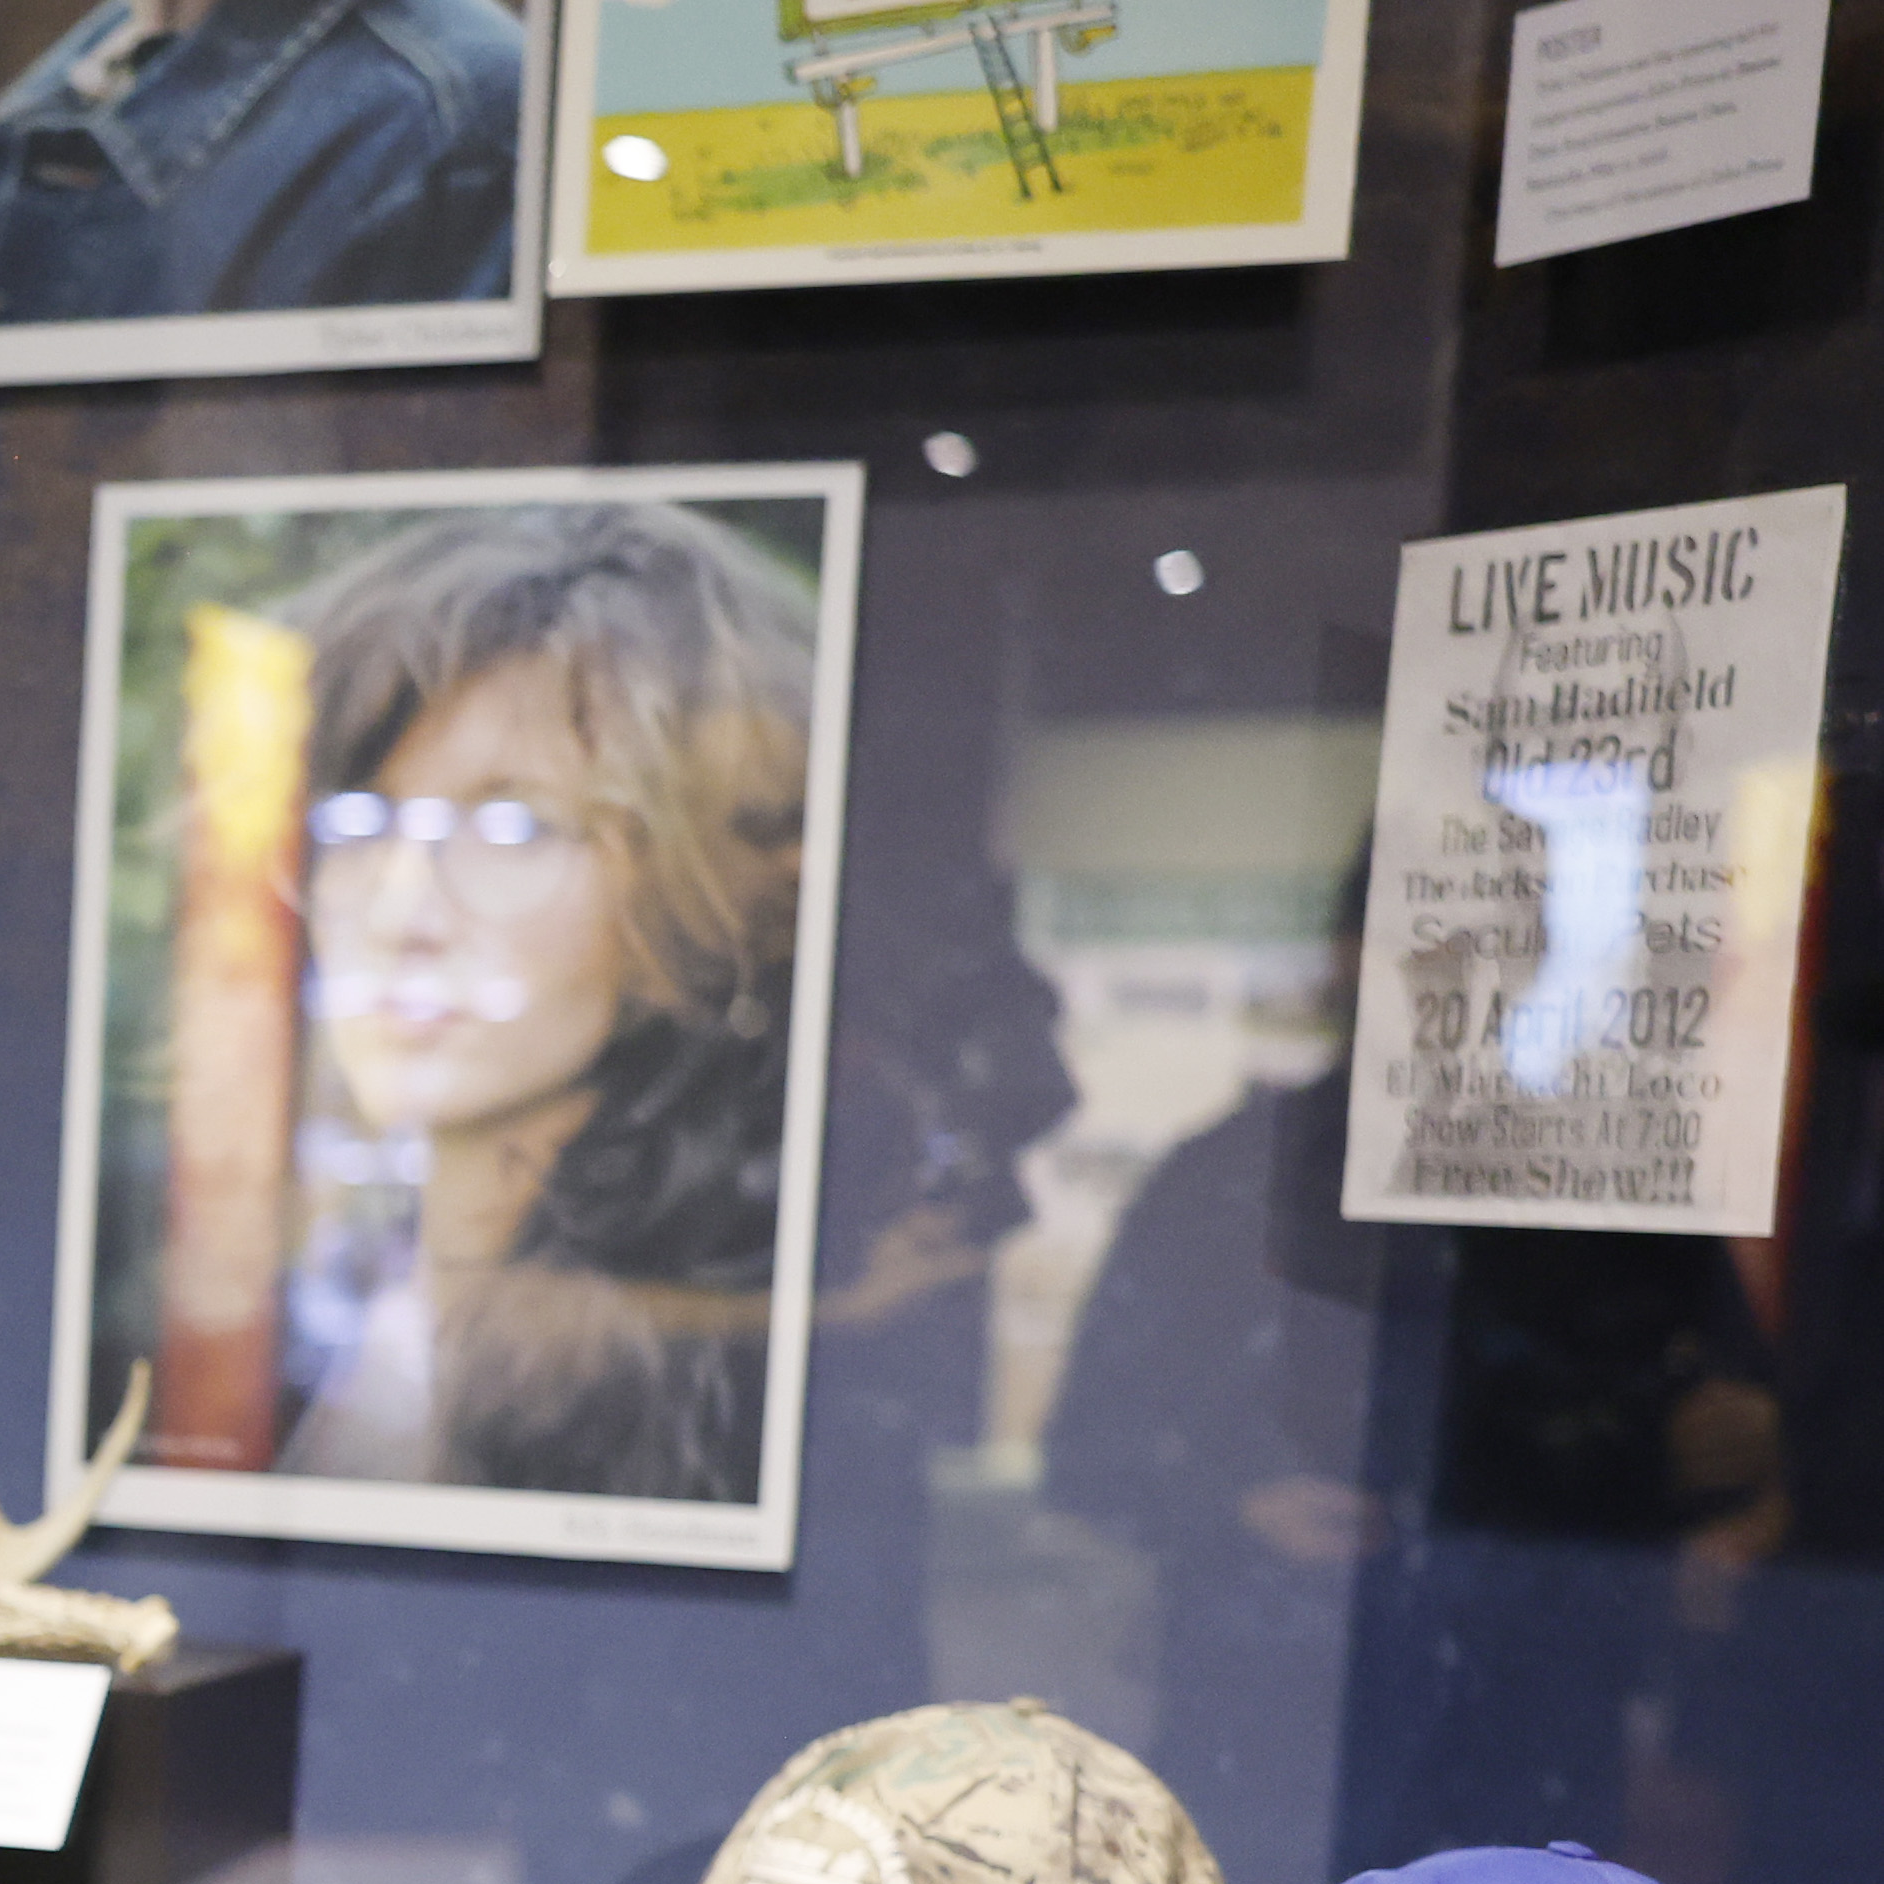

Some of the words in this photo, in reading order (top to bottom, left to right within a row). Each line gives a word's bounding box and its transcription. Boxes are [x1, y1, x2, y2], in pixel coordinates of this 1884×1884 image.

[1447, 552, 1566, 636] LIVE
[1579, 526, 1761, 622] MUSIC
[1519, 629, 1664, 676] Featuring
[1442, 692, 1536, 737] Sam
[1482, 737, 1552, 803] Old
[1565, 726, 1679, 795] 23rd
[1440, 815, 1487, 856] The
[1402, 868, 1454, 902] The
[1412, 988, 1471, 1054] 20
[1481, 985, 1585, 1064] April
[1599, 984, 1712, 1050] 2012
[1626, 1059, 1724, 1101] Loco
[1403, 1105, 1482, 1150] Show
[1491, 1103, 1587, 1150] Starts
[1595, 1108, 1630, 1150] At
[1638, 1107, 1703, 1151] 7:00
[1412, 1151, 1519, 1198] Free
[1525, 1152, 1696, 1206] Show!!!
